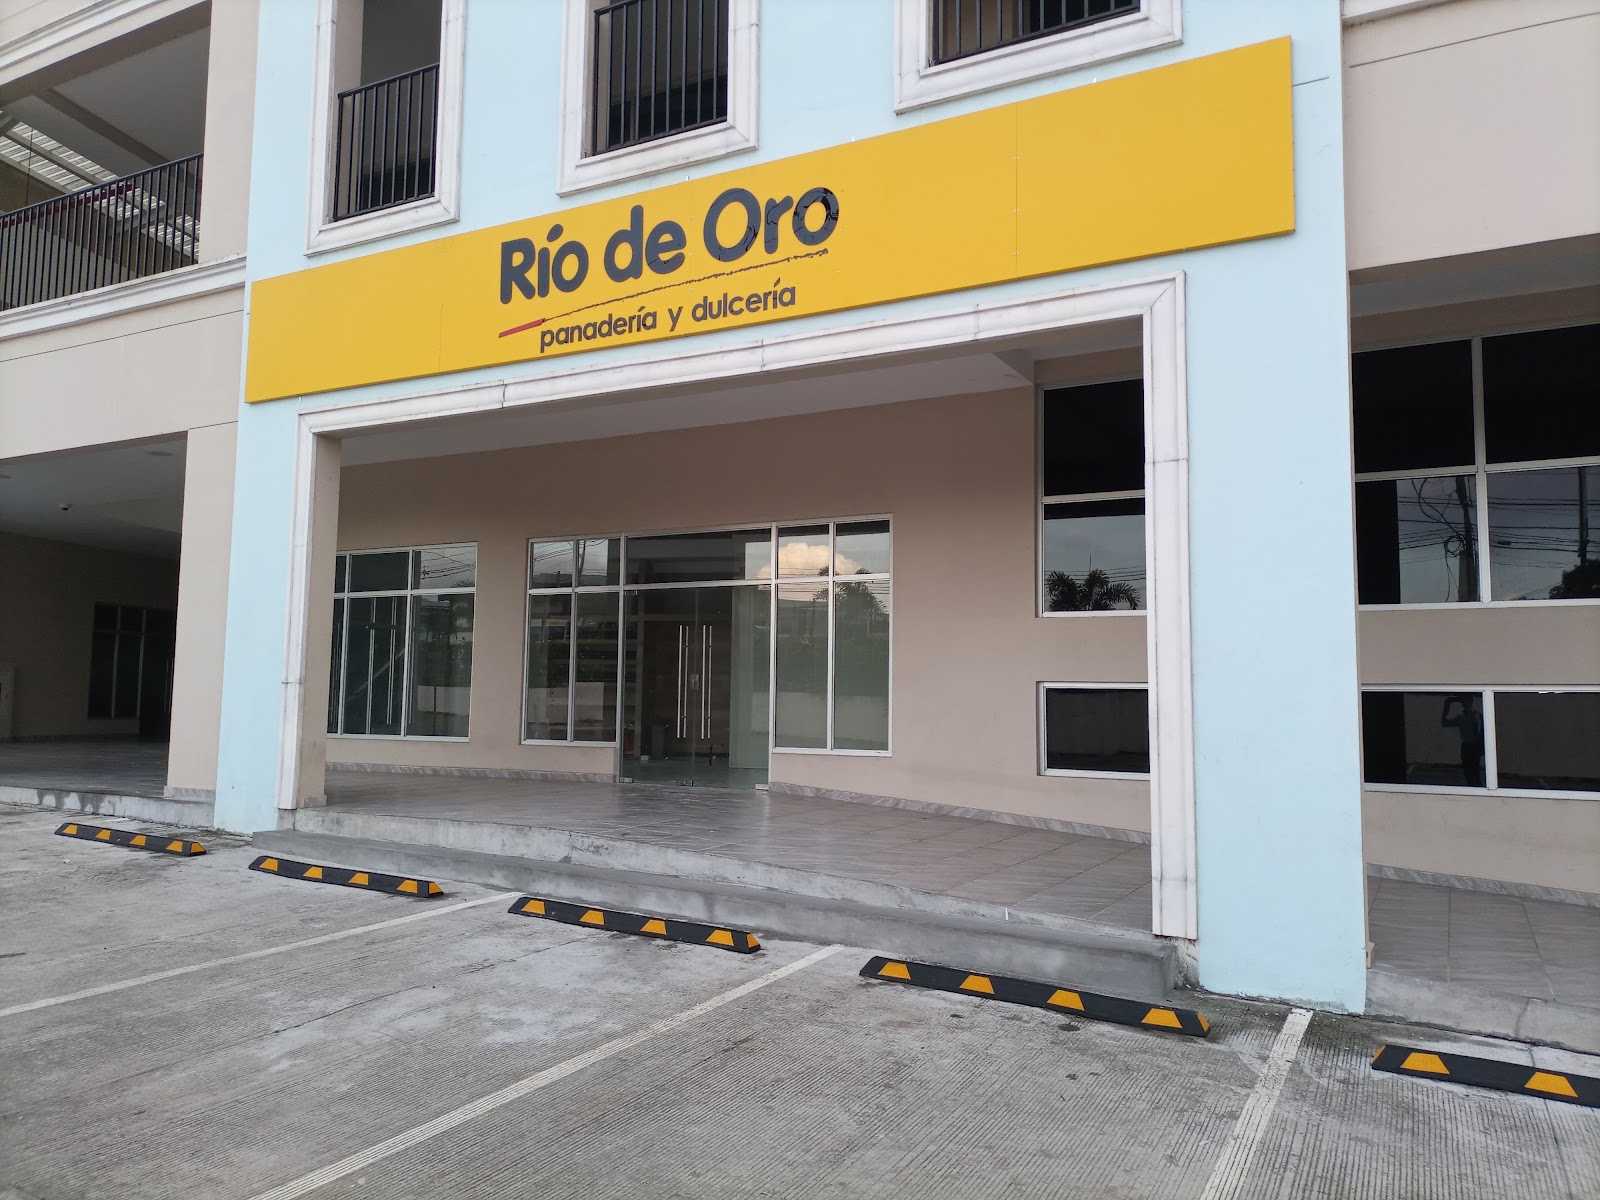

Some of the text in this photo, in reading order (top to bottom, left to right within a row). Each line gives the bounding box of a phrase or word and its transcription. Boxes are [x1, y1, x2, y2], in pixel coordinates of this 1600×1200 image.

[500, 187, 840, 304] Río de Oro
[540, 277, 796, 353] panadería y dulcería
